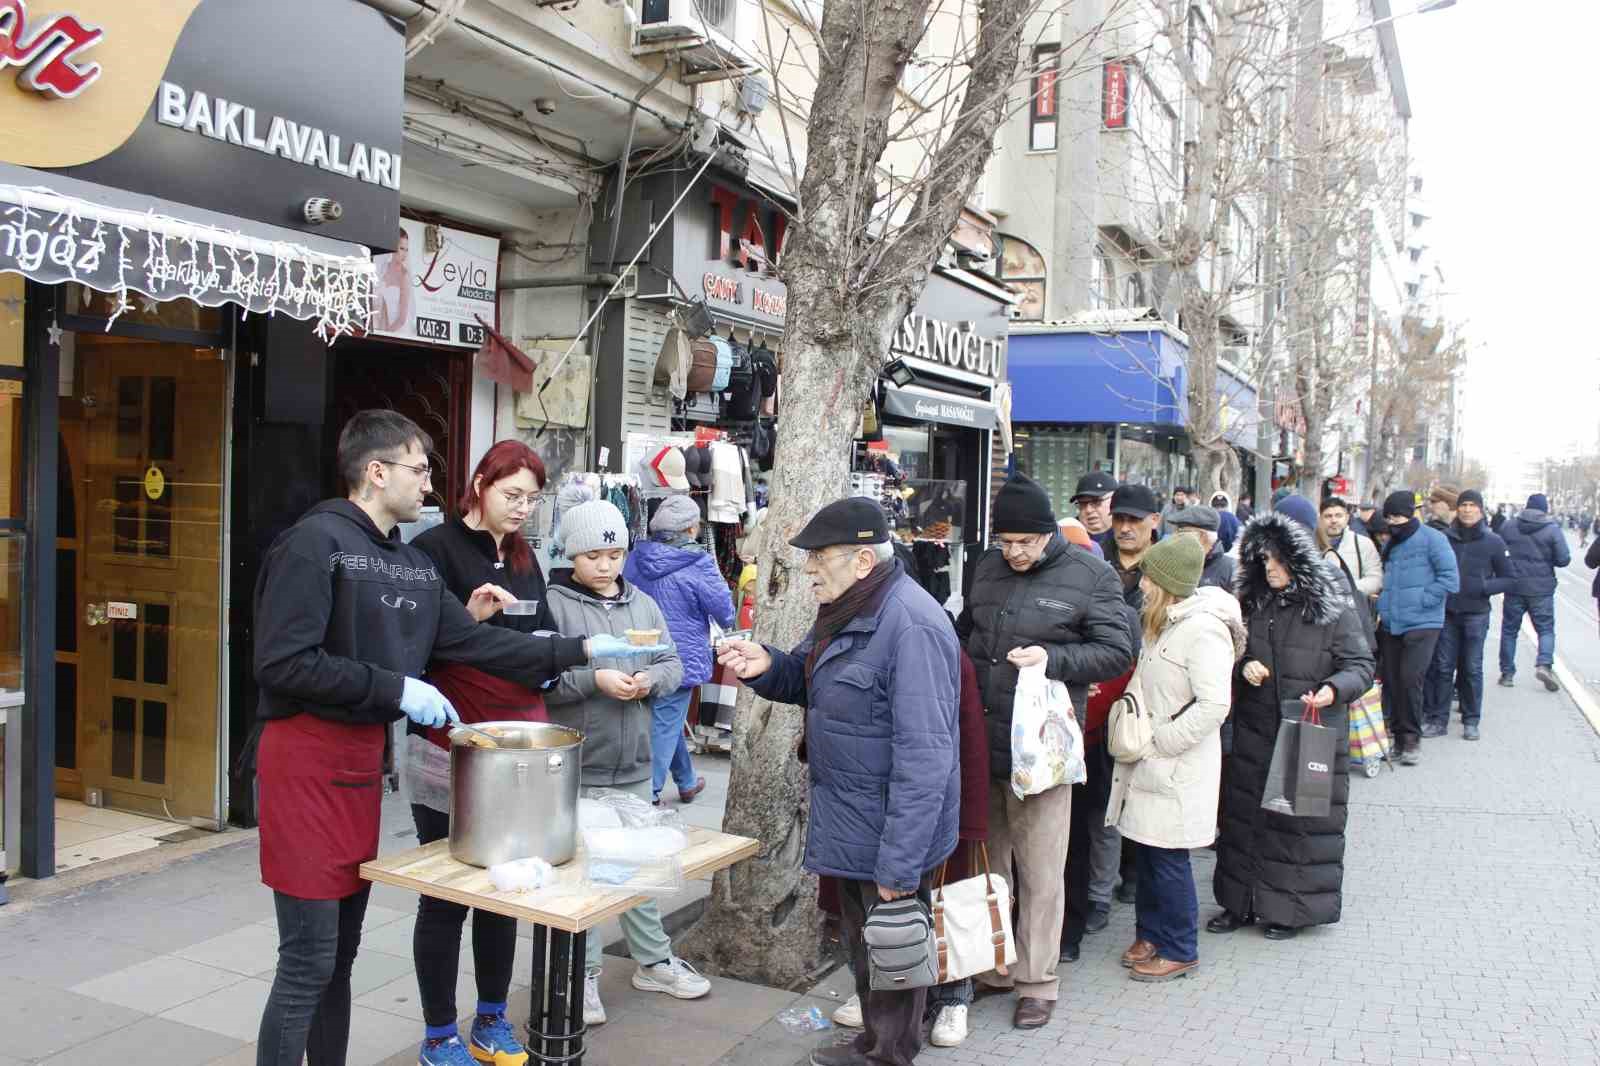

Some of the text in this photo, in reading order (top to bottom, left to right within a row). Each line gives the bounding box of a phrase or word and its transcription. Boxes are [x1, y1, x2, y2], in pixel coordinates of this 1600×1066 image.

[158, 79, 401, 190] BAKLAVALARI
[413, 236, 487, 291] Leyla
[461, 287, 483, 300] Moda
[419, 320, 447, 338] KAT: 2
[466, 326, 484, 343] D: 3
